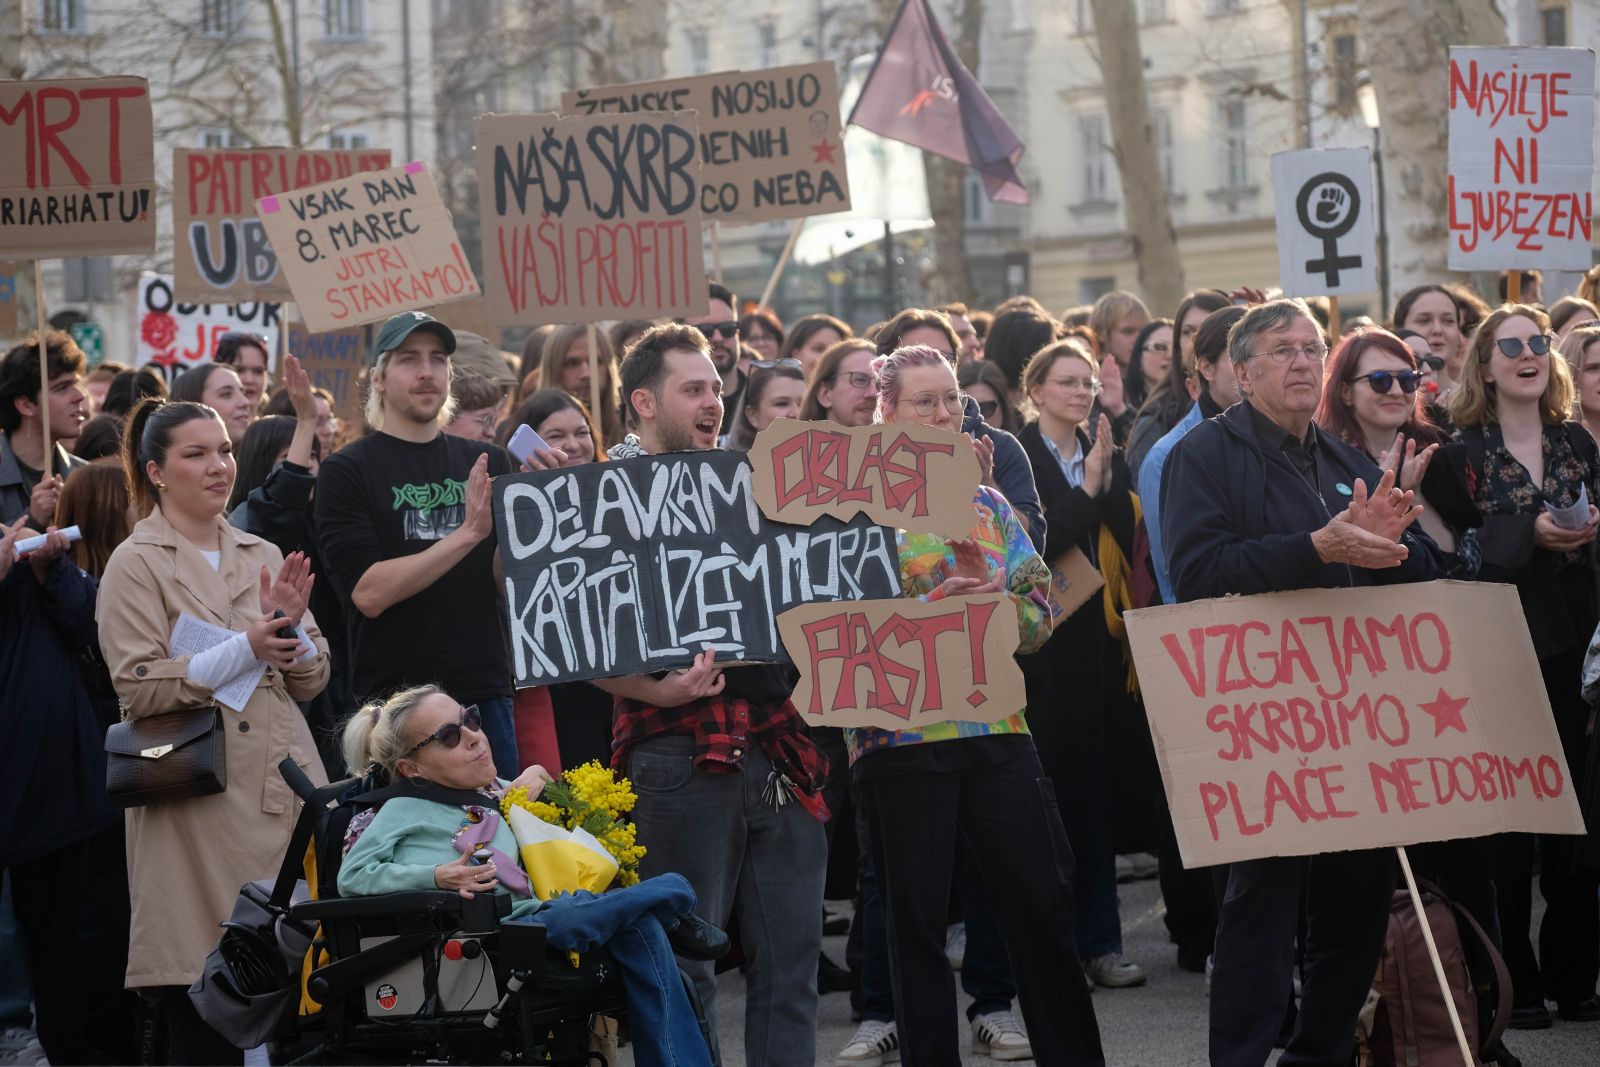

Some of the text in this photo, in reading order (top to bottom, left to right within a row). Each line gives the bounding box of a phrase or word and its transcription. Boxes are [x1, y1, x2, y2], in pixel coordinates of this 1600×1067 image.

[712, 73, 821, 118] NOSIJO
[1449, 60, 1571, 133] NASILJE
[288, 174, 416, 221] VSAK DAN
[494, 123, 695, 219] NAŠA SKRB
[753, 169, 846, 208] NEBA
[1494, 137, 1538, 184] NI
[296, 208, 420, 263] 8. MAREC
[1448, 175, 1592, 253] LJUBEZEN
[327, 243, 475, 319] STAVKAMO!
[336, 245, 408, 281] JUTRI
[498, 211, 690, 314] VAŠI PROFITI
[503, 461, 760, 560] DELAVKAM
[771, 429, 954, 517] OBLAST
[505, 526, 900, 681] KAPITALIZEM MORA
[801, 601, 1000, 720] PAST!
[1160, 611, 1452, 699] VZGAJAMO
[1206, 692, 1411, 761] SKRBIMO
[1199, 756, 1359, 841] PLAČE
